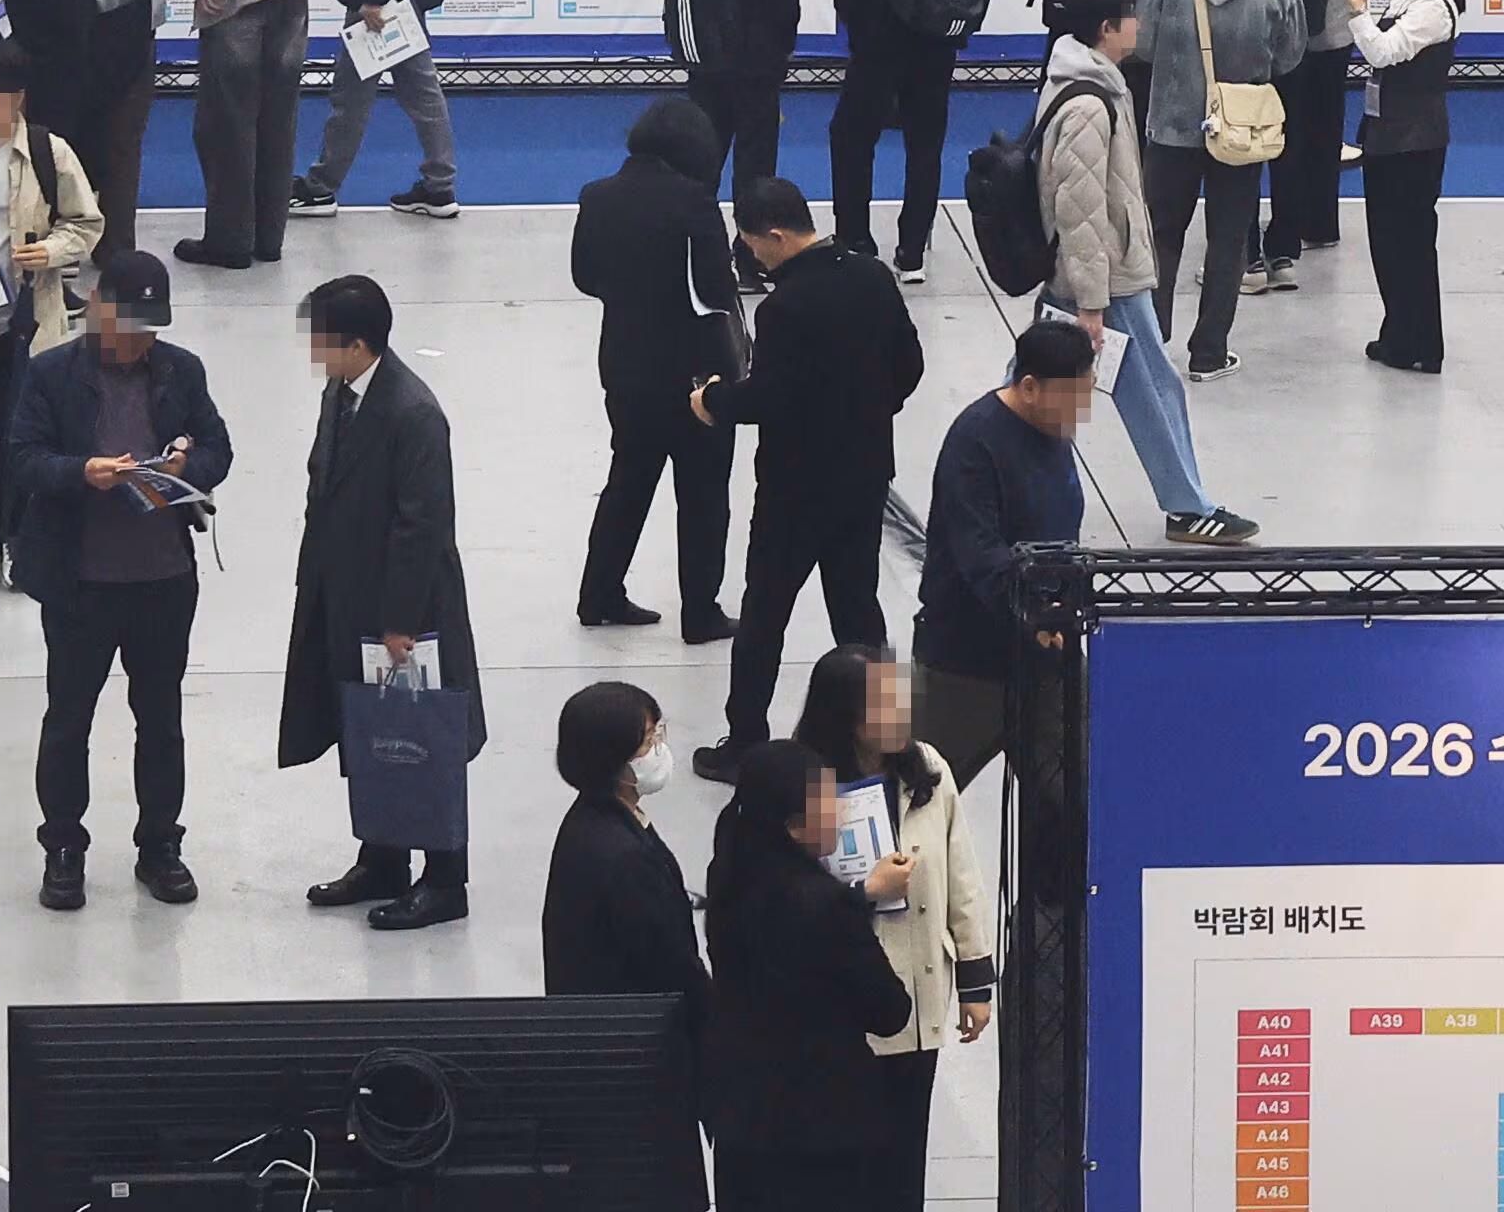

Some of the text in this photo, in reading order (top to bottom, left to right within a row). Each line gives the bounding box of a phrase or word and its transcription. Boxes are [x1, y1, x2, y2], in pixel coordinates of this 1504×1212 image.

[1302, 721, 1475, 780] 2026
[1193, 903, 1366, 935] 박람회 배치도
[1257, 1015, 1291, 1030] A40
[1370, 1014, 1403, 1028] A39
[1445, 1014, 1477, 1028] A38
[1259, 1043, 1289, 1058] A41
[1257, 1072, 1291, 1086] A42
[1257, 1100, 1290, 1114] A43
[1256, 1128, 1289, 1142] A44
[1256, 1157, 1289, 1171] A45
[1256, 1185, 1289, 1199] A46
